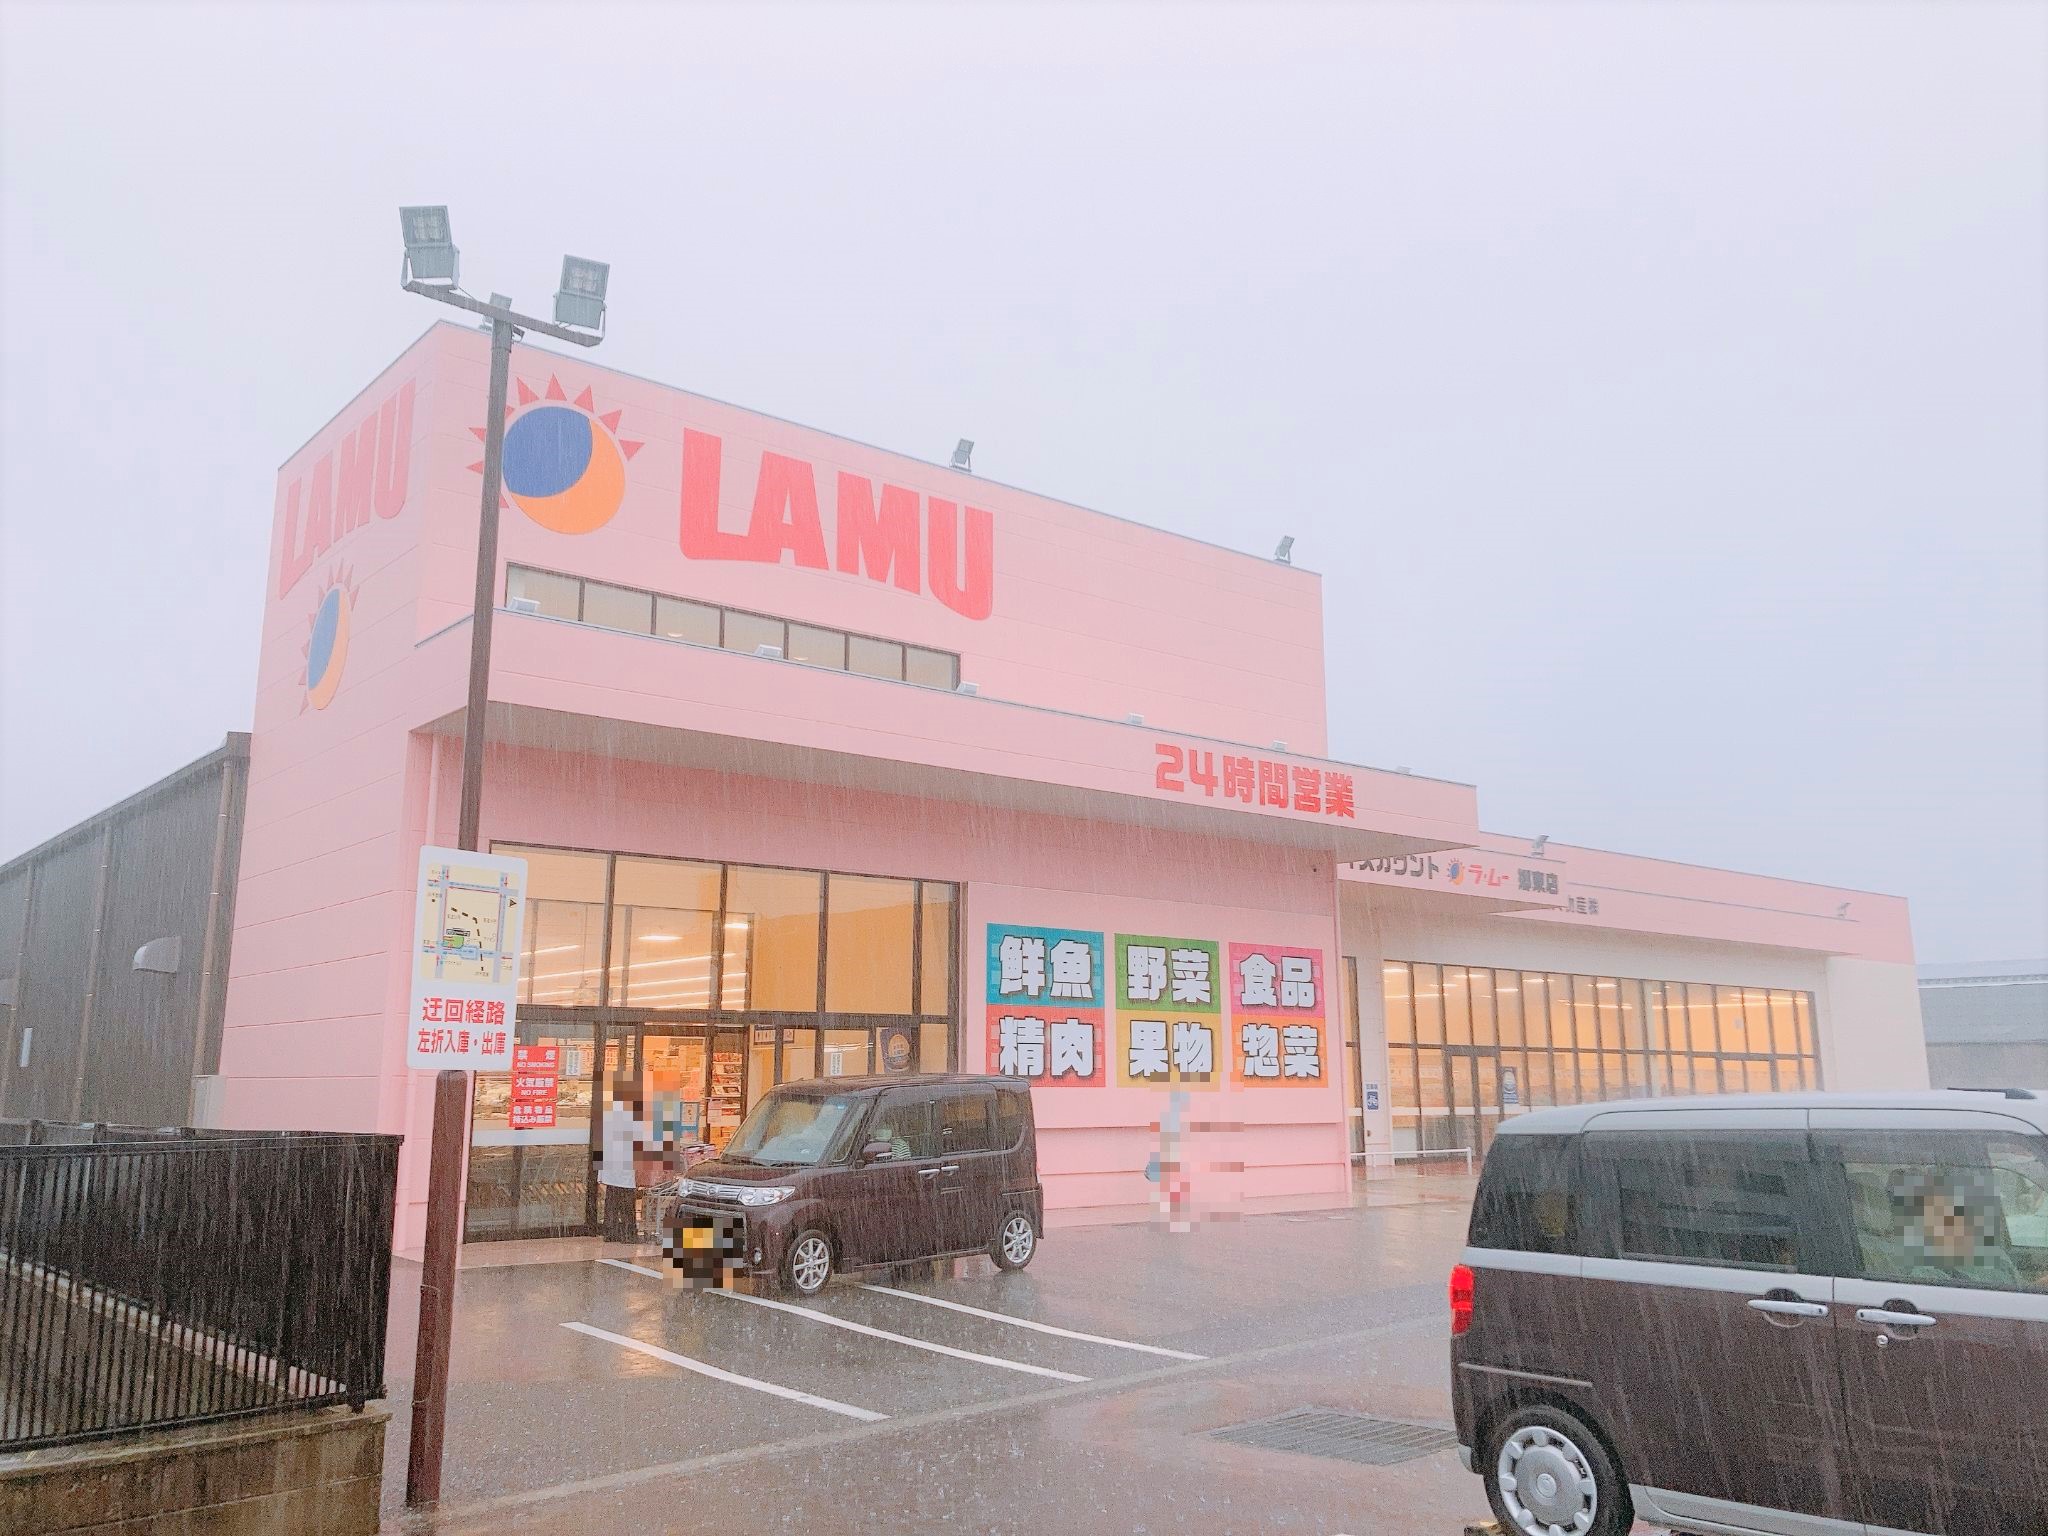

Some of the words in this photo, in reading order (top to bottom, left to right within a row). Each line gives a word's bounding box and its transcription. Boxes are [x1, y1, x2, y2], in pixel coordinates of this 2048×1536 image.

[280, 377, 416, 600] LAMU
[680, 427, 994, 621] LAMU
[1155, 743, 1355, 819] 24時間営業
[998, 934, 1094, 1000] 鮮魚
[1127, 944, 1212, 1004] 野菜
[1240, 952, 1317, 1008] 食品
[422, 996, 506, 1026] 迂回経路
[417, 1028, 507, 1056] 左折入庫・出庫
[998, 1015, 1095, 1078] 精肉
[1128, 1018, 1213, 1077] 果物
[1242, 1022, 1320, 1078] 惣菜
